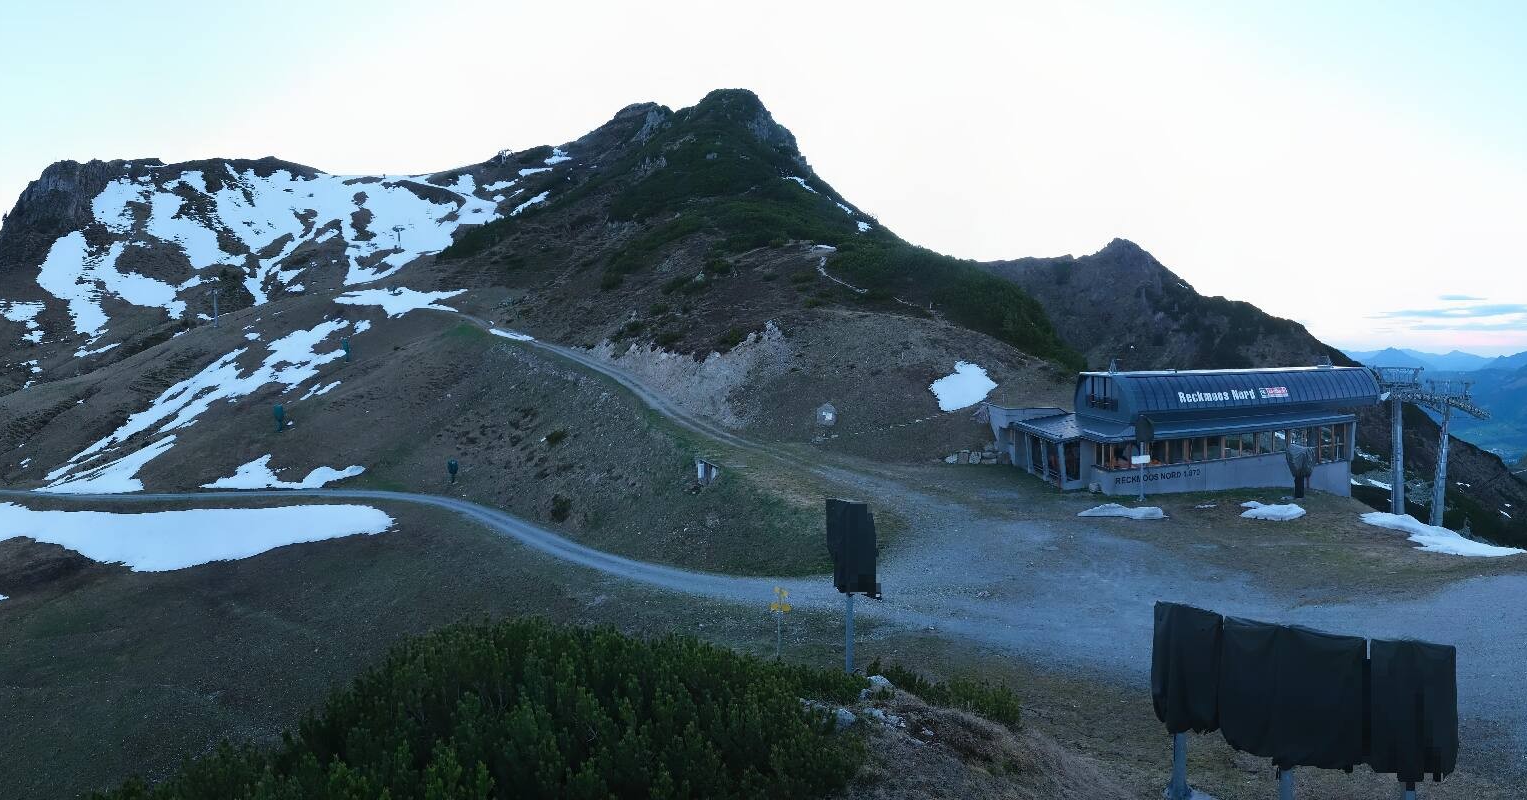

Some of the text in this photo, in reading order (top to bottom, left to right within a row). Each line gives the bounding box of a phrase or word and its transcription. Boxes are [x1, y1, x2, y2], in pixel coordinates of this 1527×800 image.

[1178, 391, 1230, 403] Reckmoos
[1231, 388, 1256, 400] Nord
[1115, 473, 1159, 485] RECKMOOS
[1161, 471, 1181, 480] NORD
